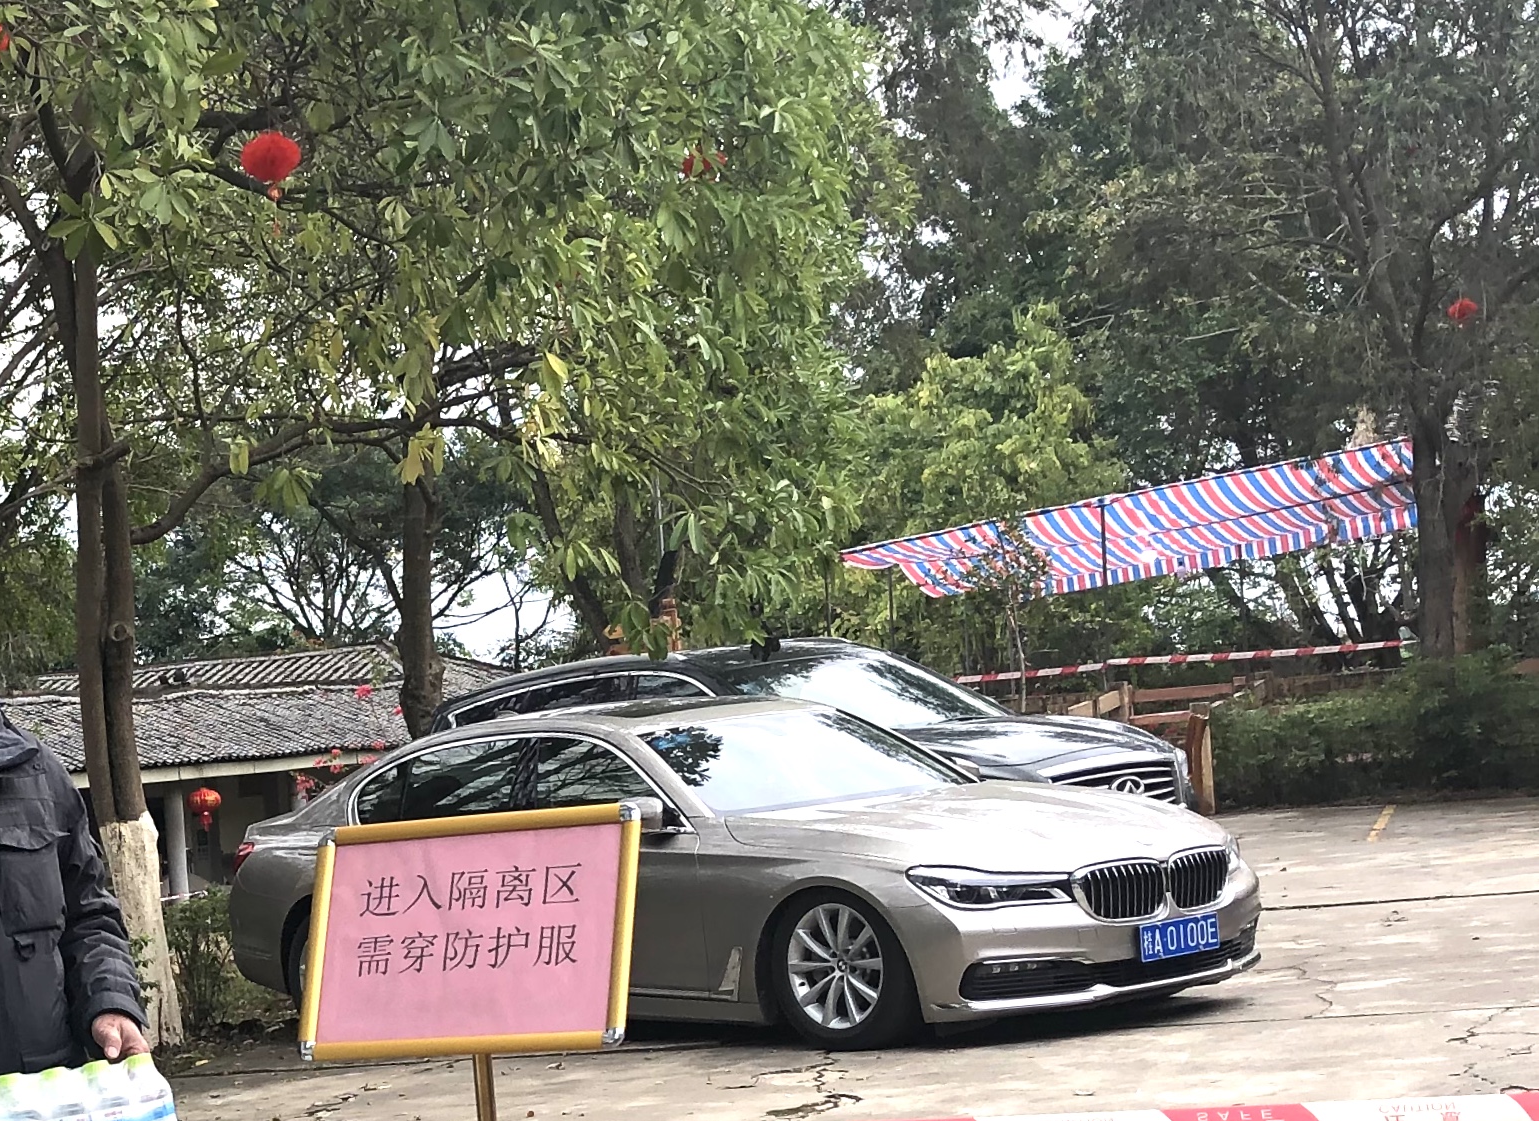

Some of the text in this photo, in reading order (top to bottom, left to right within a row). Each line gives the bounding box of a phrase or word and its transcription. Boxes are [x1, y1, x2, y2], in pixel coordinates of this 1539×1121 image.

[359, 862, 583, 918] 进入隔离区
[356, 923, 579, 978] 需穿防护服
